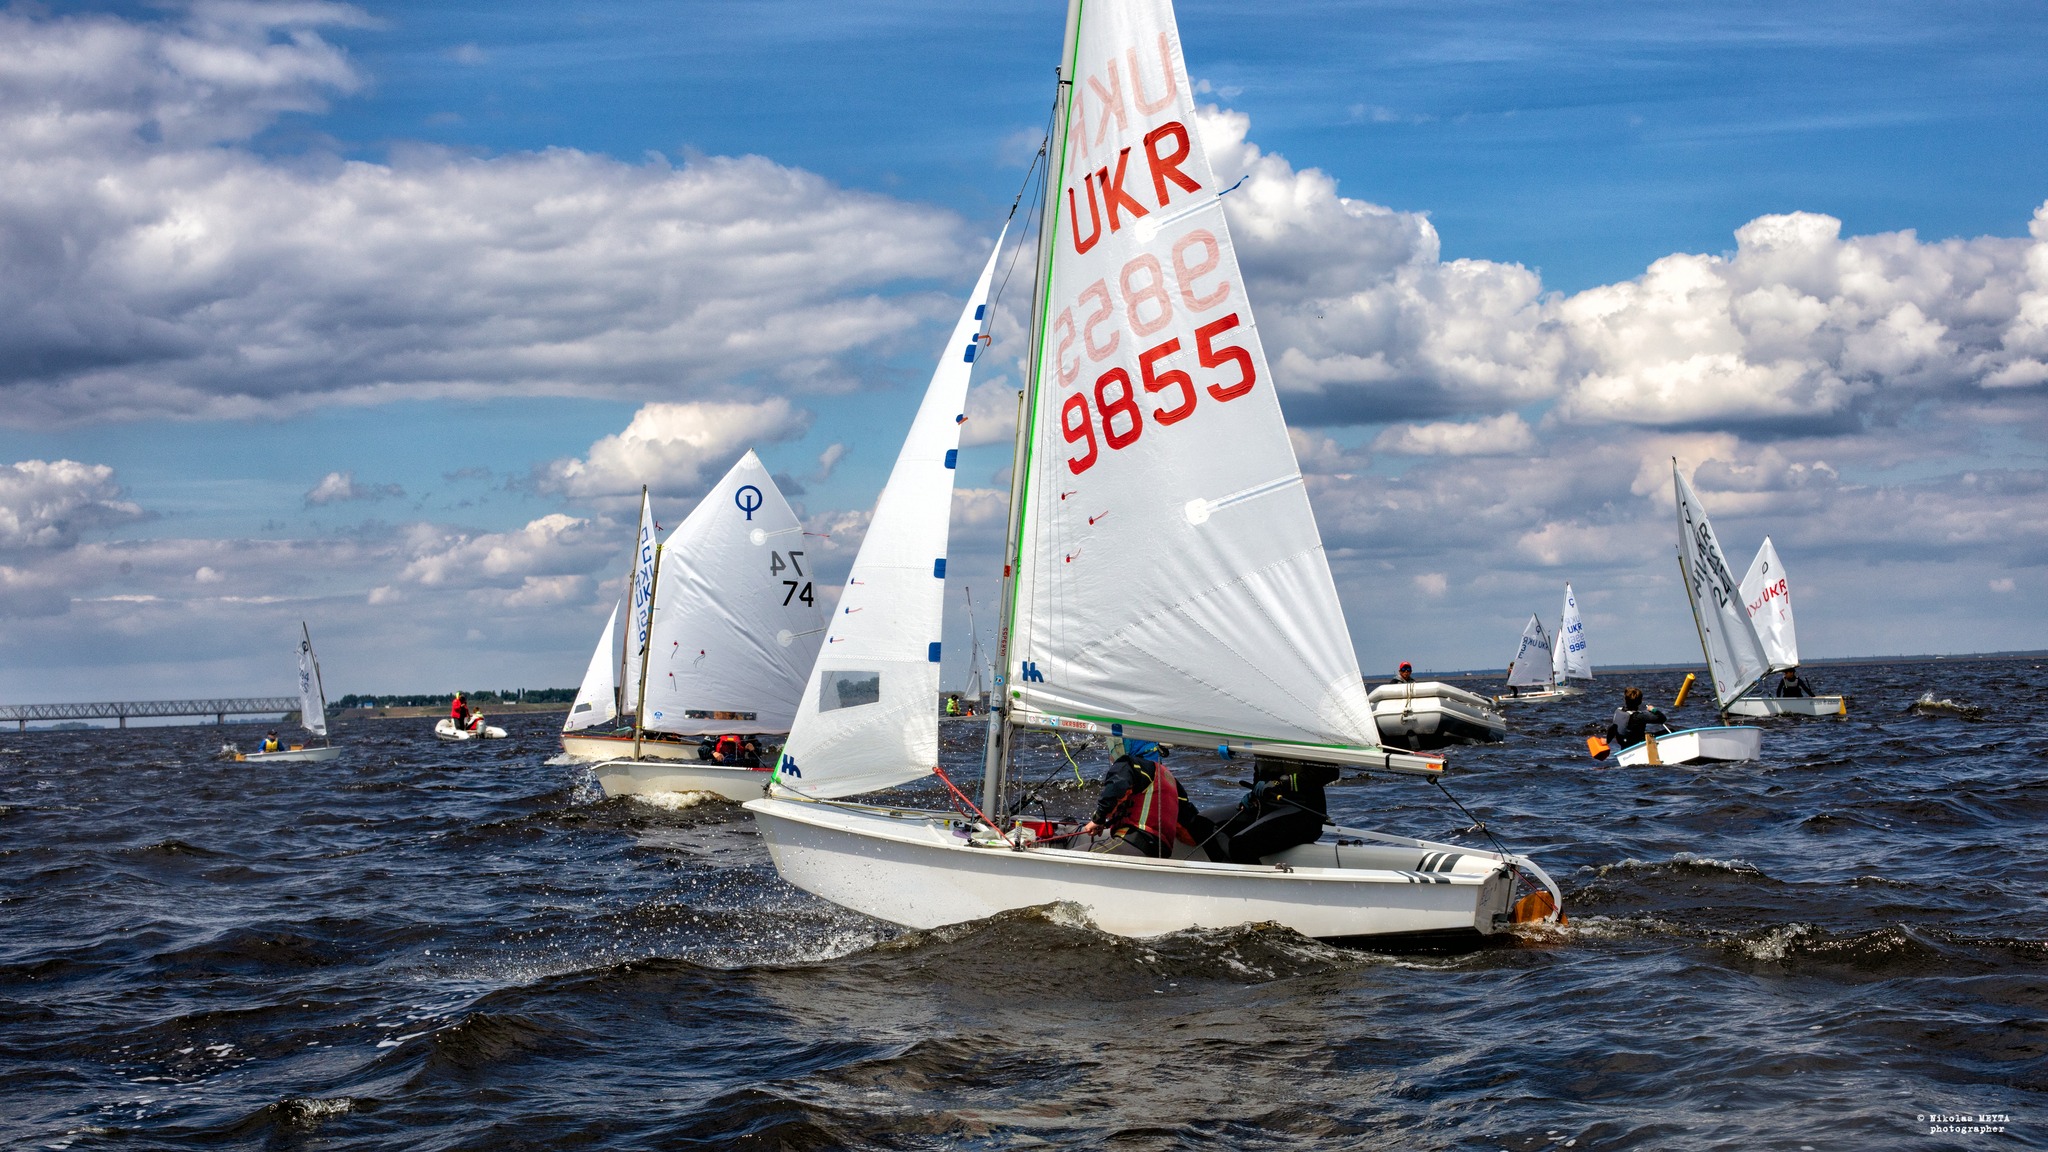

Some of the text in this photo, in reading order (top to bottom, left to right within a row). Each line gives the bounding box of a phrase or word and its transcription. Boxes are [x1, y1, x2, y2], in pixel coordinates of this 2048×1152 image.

[1068, 121, 1203, 255] UKR
[1061, 312, 1256, 475] 9855
[635, 581, 652, 608] UK
[782, 580, 814, 608] 74
[1762, 578, 1787, 603] UKR
[1567, 622, 1582, 633] UKR
[1062, 720, 1087, 729] UKR9855
